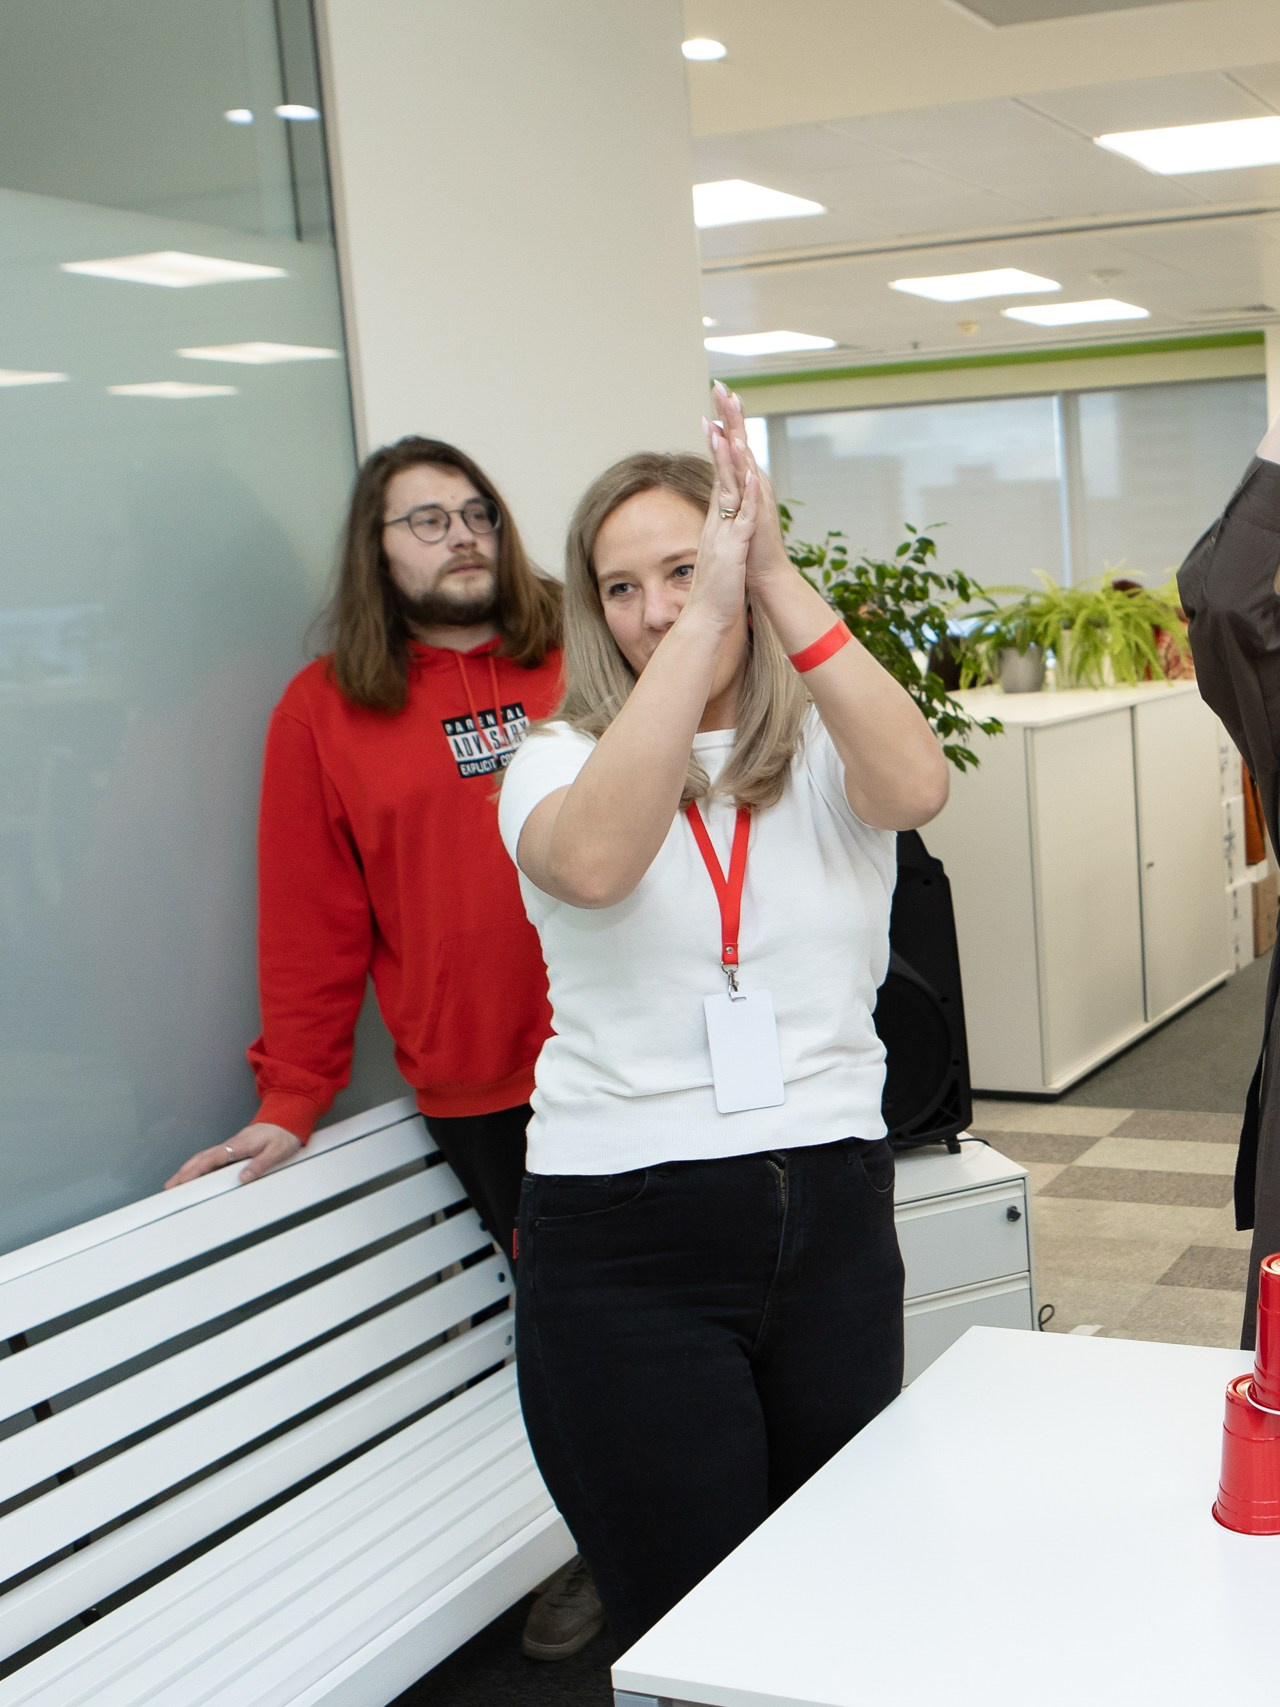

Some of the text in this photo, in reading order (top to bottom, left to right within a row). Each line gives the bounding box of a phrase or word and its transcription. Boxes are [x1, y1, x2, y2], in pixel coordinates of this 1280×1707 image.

[444, 706, 524, 735] PARENAL
[451, 720, 528, 758] ADVSRY
[460, 759, 497, 775] EXPLICIT
